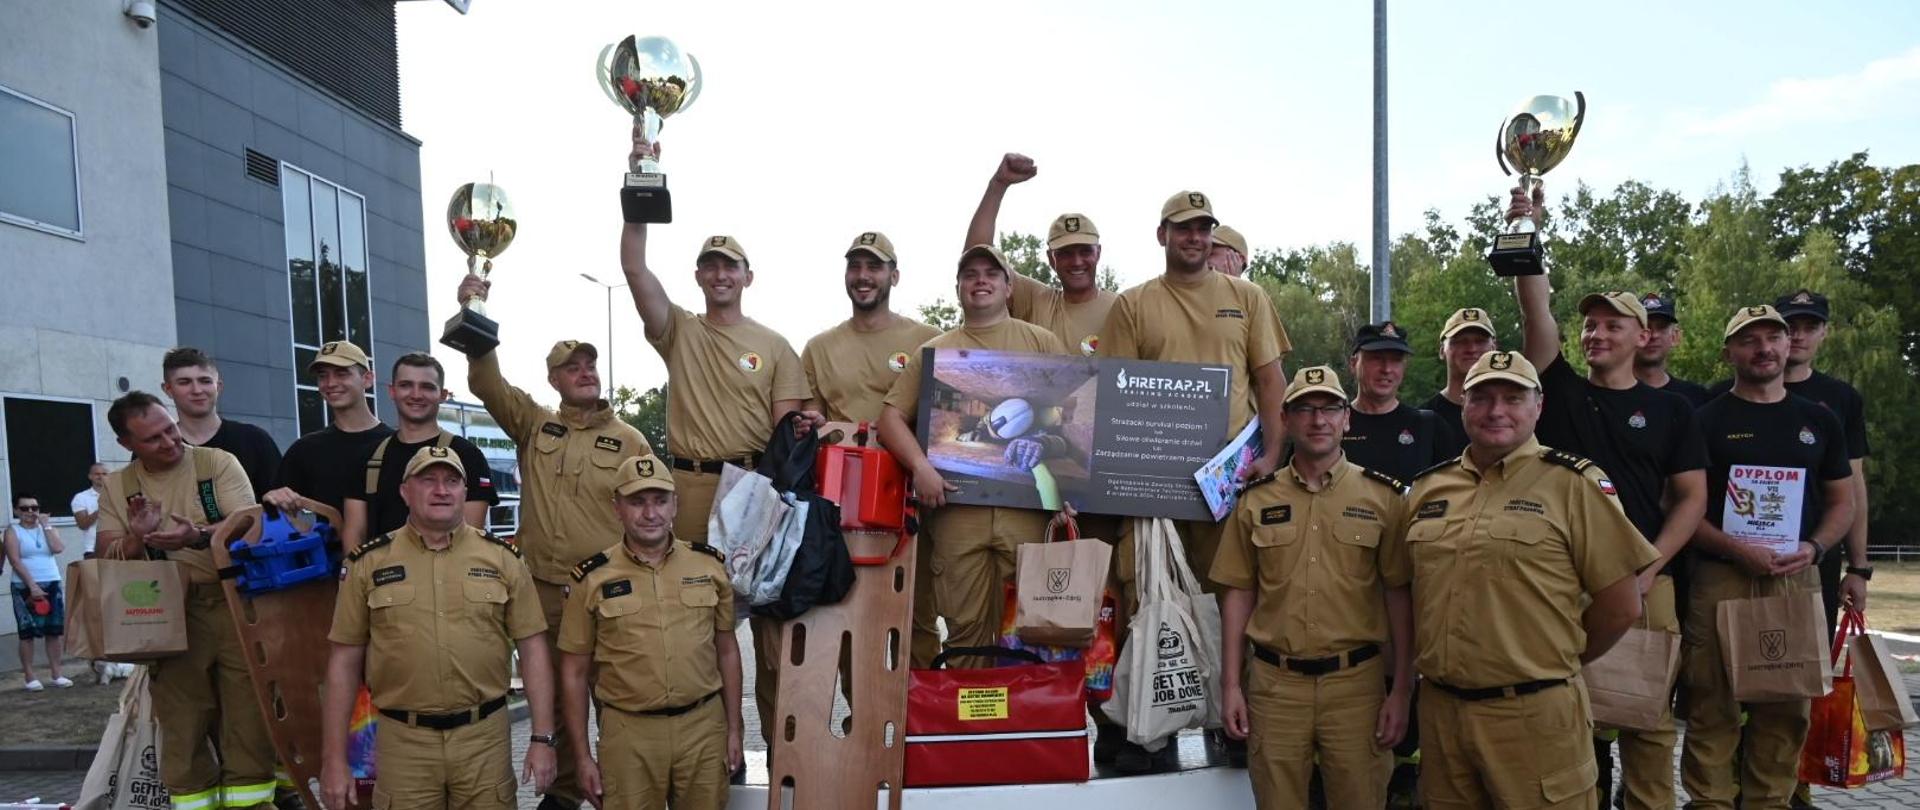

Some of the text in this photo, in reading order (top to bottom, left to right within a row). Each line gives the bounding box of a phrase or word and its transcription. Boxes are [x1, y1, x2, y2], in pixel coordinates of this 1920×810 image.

[1128, 376, 1212, 393] FIRETRAP.PL
[1734, 468, 1799, 481] DYPLOM
[1152, 670, 1200, 690] GET THE
[1152, 684, 1203, 703] JOB DONE
